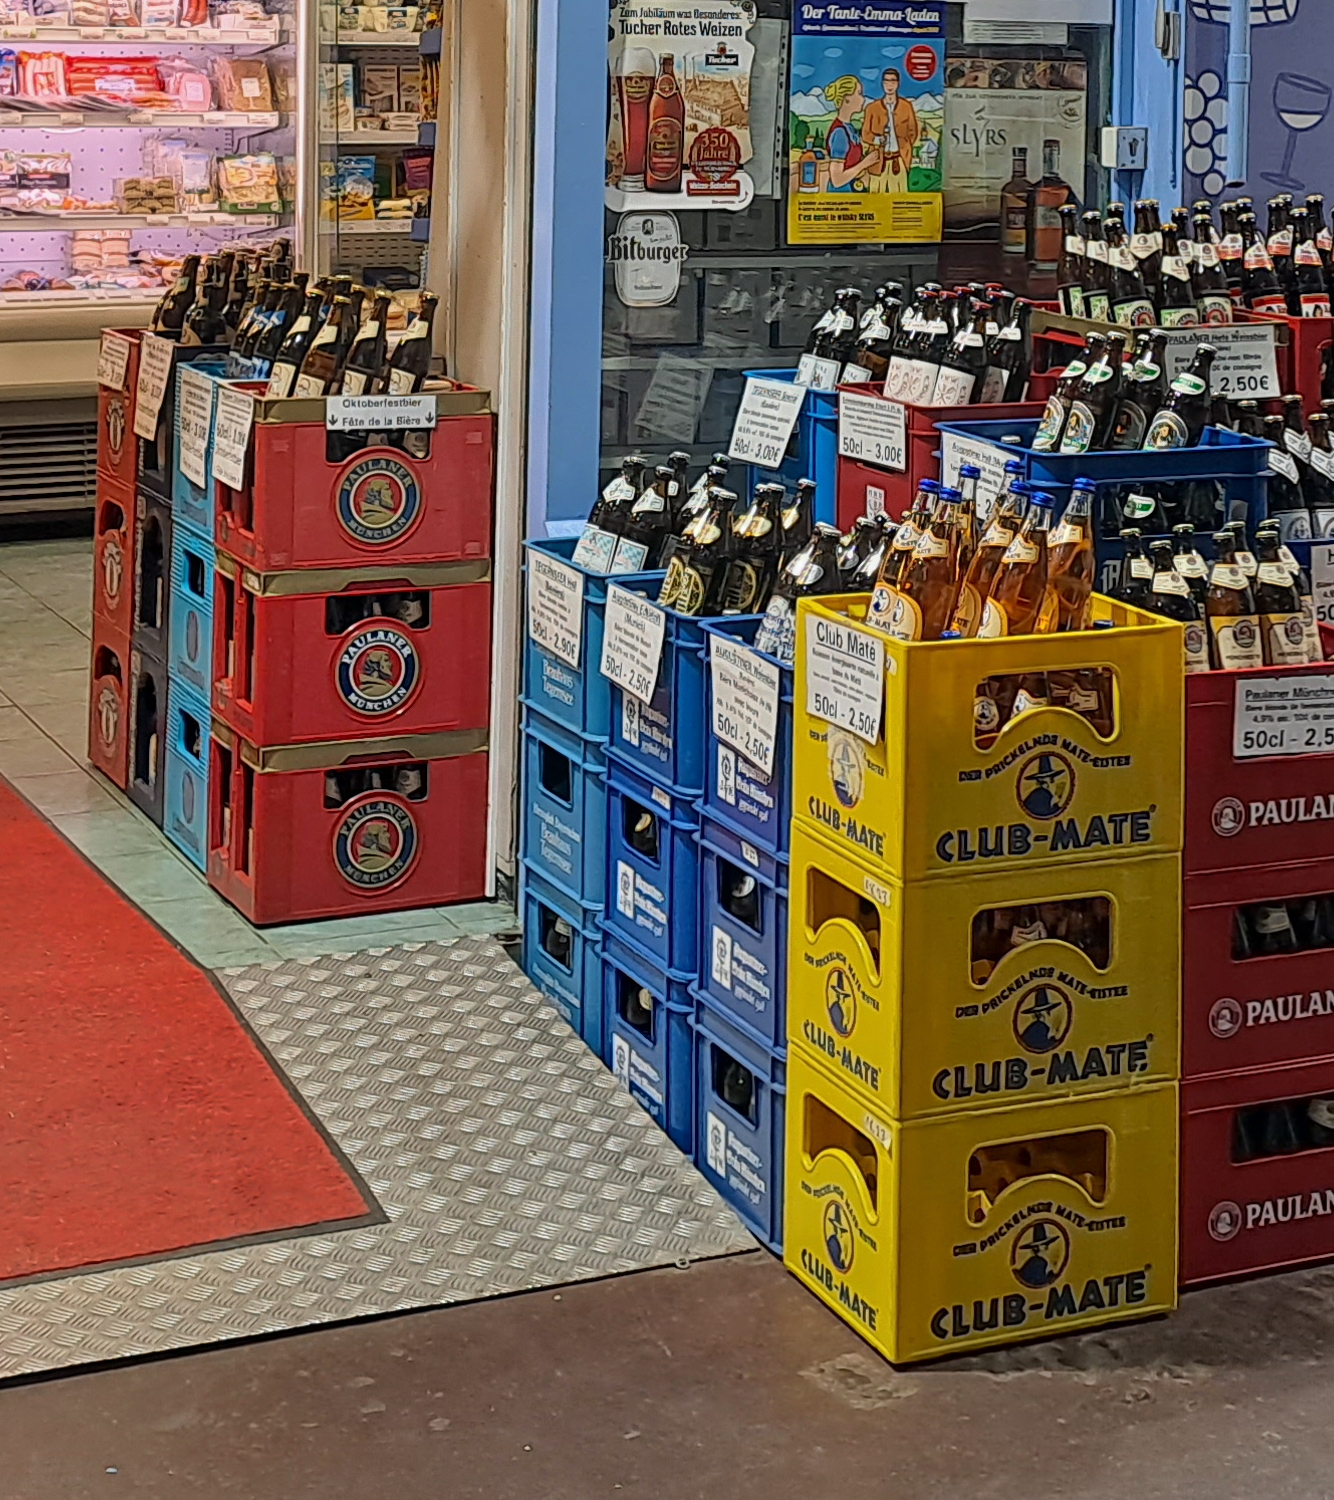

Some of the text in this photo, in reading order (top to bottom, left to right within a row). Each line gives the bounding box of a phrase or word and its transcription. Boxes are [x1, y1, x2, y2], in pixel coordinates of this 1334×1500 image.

[619, 19, 742, 37] Tucher Rotes Weizen
[802, 4, 940, 26] Der Tante-Emma-Laden
[700, 132, 729, 148] 350
[607, 236, 688, 264] Bitburger
[1220, 375, 1270, 393] 2,50€
[342, 398, 422, 409] Oktoberfestbier
[342, 413, 422, 427] Fête de la Bière
[842, 437, 865, 455] 50cl
[341, 458, 415, 494] PAULANER
[341, 629, 413, 666] PAULANER
[816, 622, 876, 662] Club Maté
[605, 655, 652, 698] 50cl 2,50€
[347, 686, 408, 712] MÜNCHEN
[813, 693, 877, 739] 50cl 2,50€
[717, 715, 770, 765] 50cl 2,50€
[985, 733, 1059, 780] PRICKELNDE
[1243, 729, 1286, 750] 50cl
[808, 797, 884, 857] CLUB-MATE
[936, 811, 1151, 863] CLUB-MATE
[981, 966, 1055, 1014] PRICKELNDE
[803, 1019, 880, 1092] CLUB-MATE
[932, 1040, 1149, 1101] CLUB-MATE
[800, 1247, 878, 1332] CLUB-MATE
[930, 1269, 1146, 1340] CLUB-MATE
